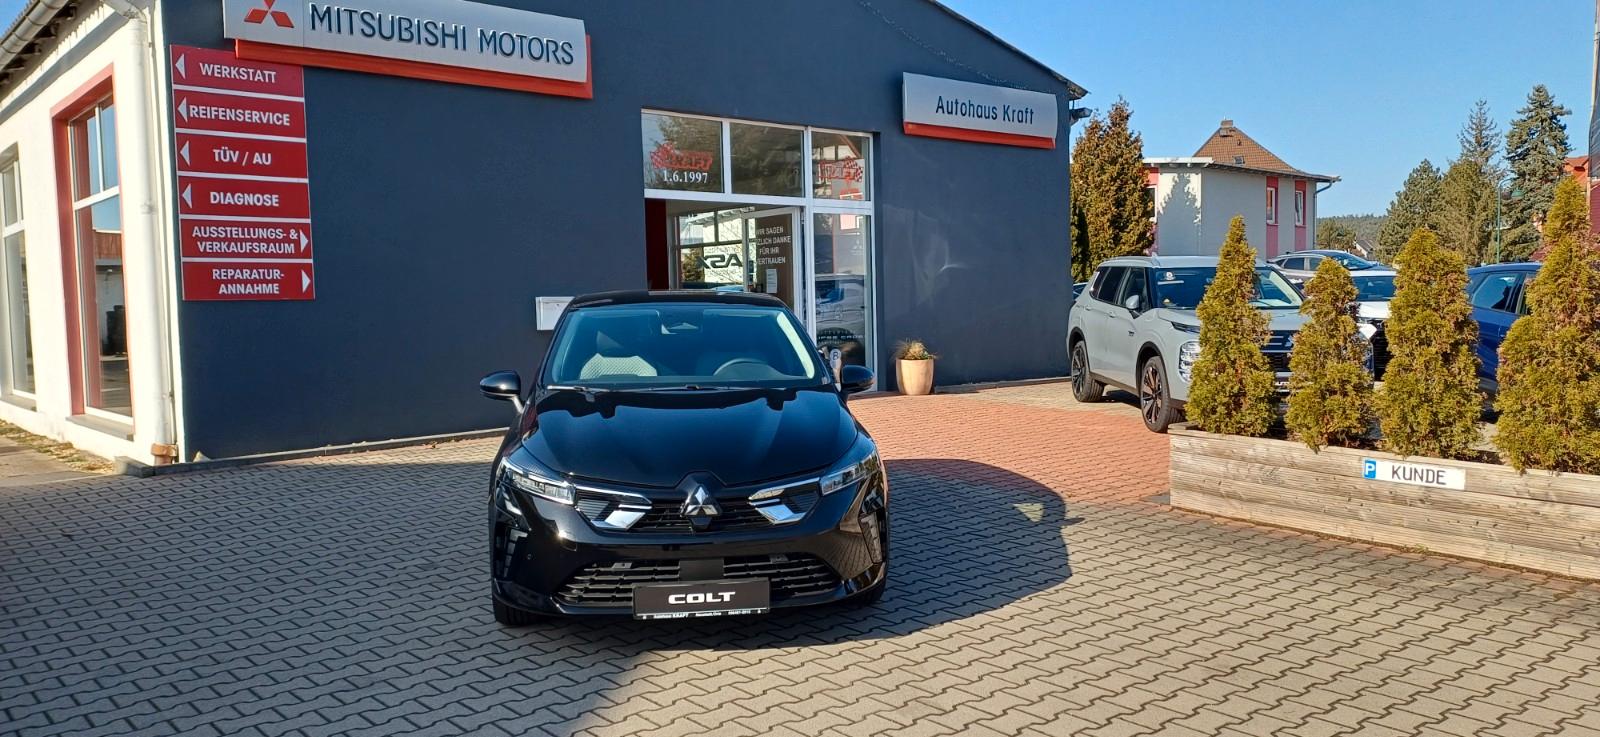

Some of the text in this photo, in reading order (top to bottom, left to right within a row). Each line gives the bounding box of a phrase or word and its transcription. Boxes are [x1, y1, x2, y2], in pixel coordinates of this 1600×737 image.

[309, 3, 574, 65] MITSUBISHI MOTORS
[199, 62, 276, 83] WERKSTATT
[189, 105, 290, 126] REIFENSERVICE
[936, 95, 1034, 125] Autohaus Kraft
[213, 146, 239, 163] TÜV
[252, 152, 272, 165] AU
[663, 170, 708, 184] 1.6.1997
[209, 191, 280, 207] DIAGNOSE
[192, 226, 298, 240] AUSSTELLUNGS- &
[197, 241, 295, 254] VERKAUFSRAUM
[212, 268, 285, 280] REPARATUR-
[218, 283, 280, 295] ANNAHME
[1364, 462, 1447, 486] P KUNDE
[668, 591, 736, 604] COLT
